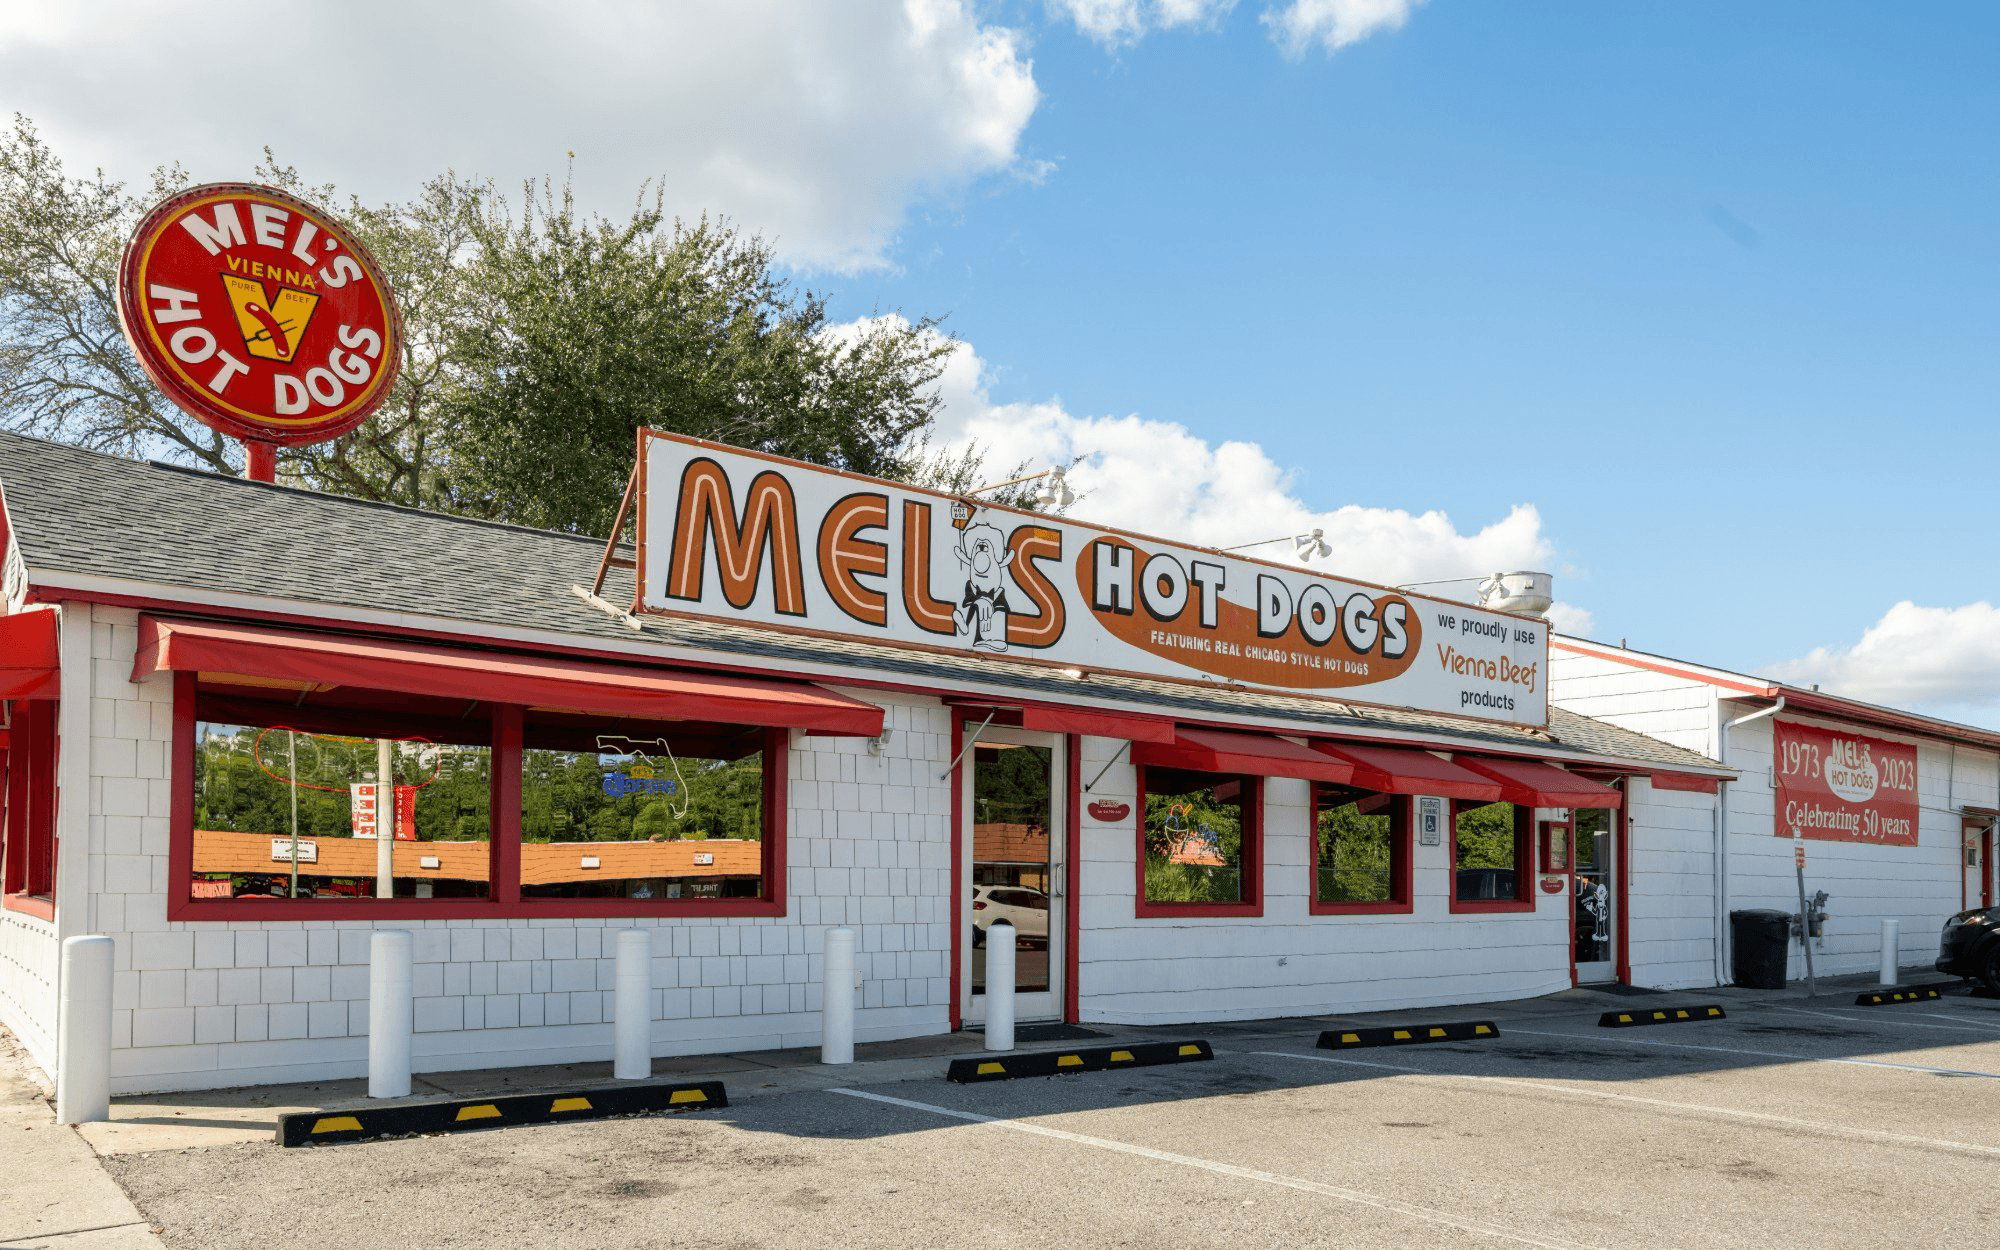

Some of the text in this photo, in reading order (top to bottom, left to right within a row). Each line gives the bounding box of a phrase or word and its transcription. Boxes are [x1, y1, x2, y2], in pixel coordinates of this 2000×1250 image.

[179, 203, 363, 288] MEL'S
[226, 254, 315, 289] VIENNA
[231, 280, 311, 304] PURE BEEF
[150, 284, 381, 415] HOT DOGS
[1092, 540, 1409, 659] HOT DOGS
[1438, 613, 1535, 644] we proudly use
[1151, 630, 1369, 676] FEATURING REAL CHICAGO STYLE HOT DOGS
[1437, 643, 1537, 694] Vienna Beef
[1461, 690, 1514, 710] products
[1781, 740, 1820, 778] 1973
[1881, 756, 1914, 791] 2023
[1832, 770, 1873, 789] HOT DOGS
[1786, 800, 1910, 839] Celebrating 50 years
